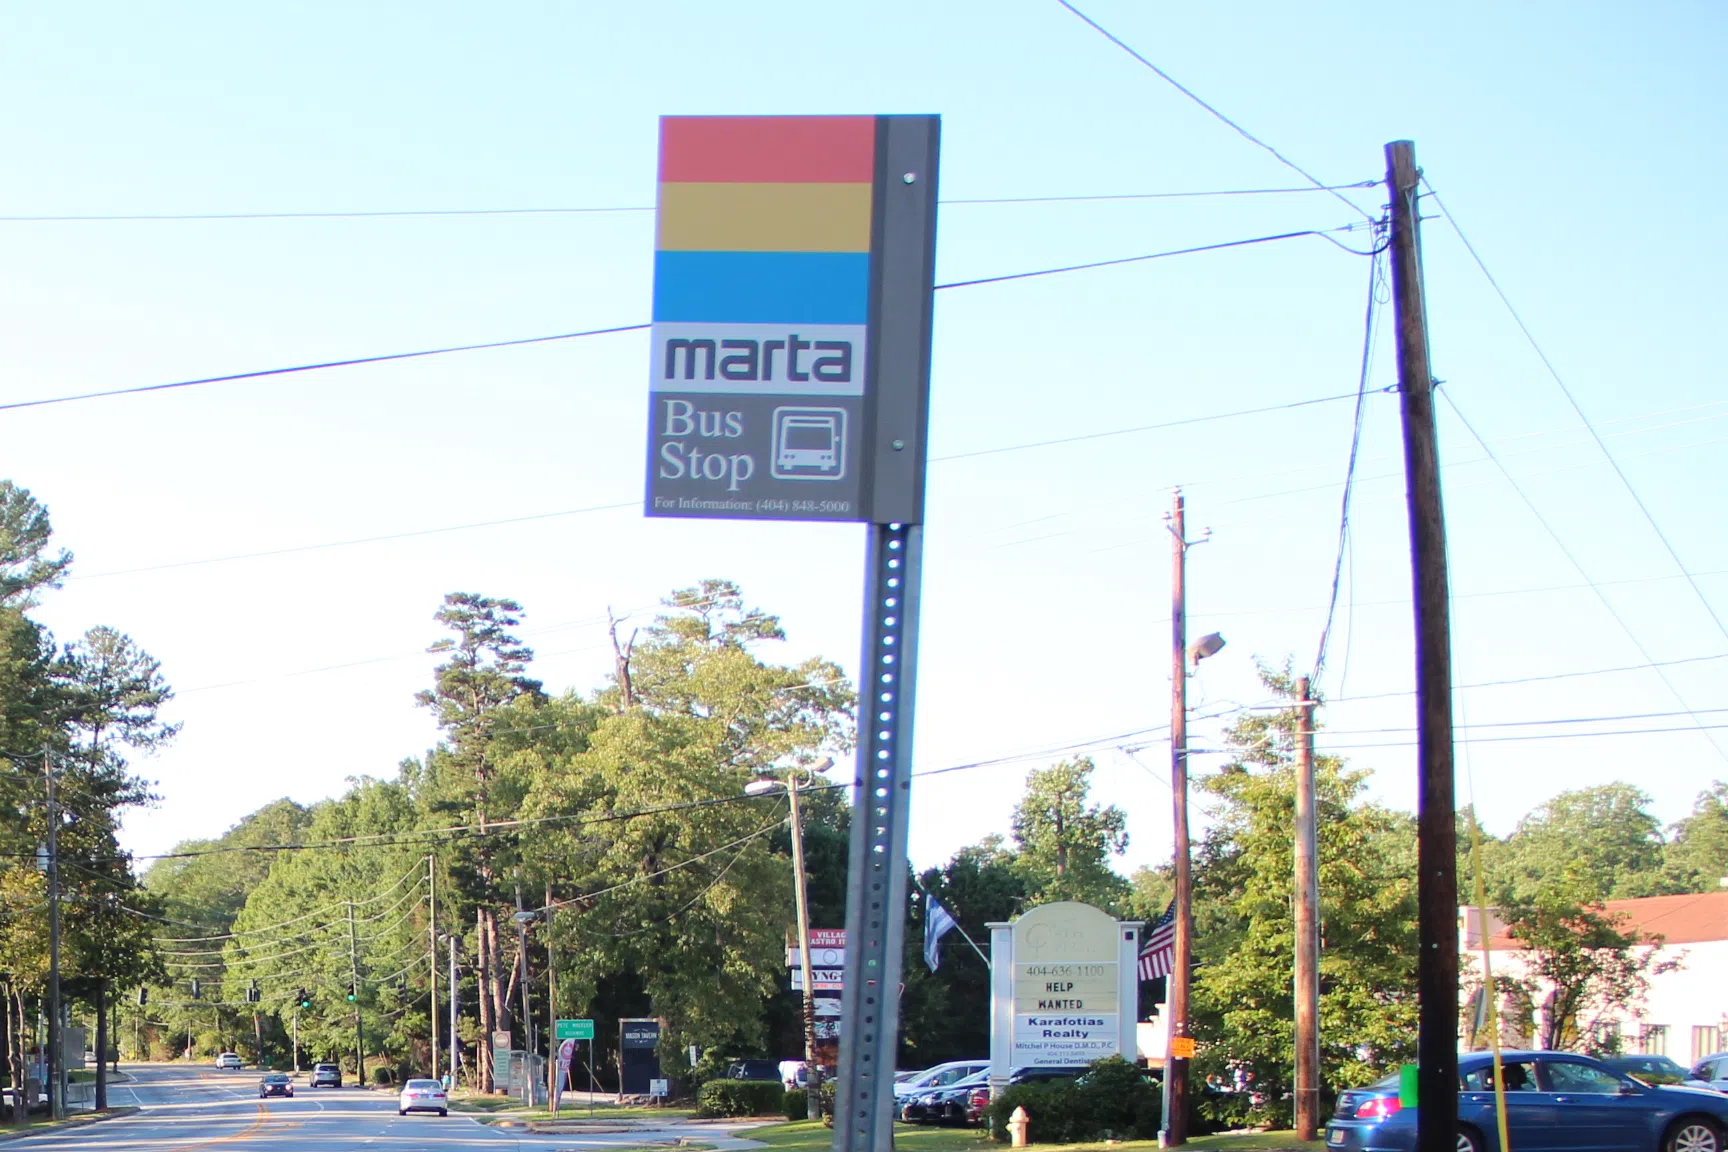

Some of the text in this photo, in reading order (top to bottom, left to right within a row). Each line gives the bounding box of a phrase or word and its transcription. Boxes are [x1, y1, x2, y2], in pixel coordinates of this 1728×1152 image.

[664, 334, 852, 383] marta
[661, 399, 744, 438] Bus
[660, 441, 755, 492] Stop
[654, 496, 850, 513] For Information: (404) 848-5000
[1046, 982, 1074, 992] HELP
[1038, 999, 1083, 1009] WANTED
[1028, 1017, 1104, 1026] Karafotias
[1043, 1029, 1089, 1039] Realty
[1033, 1057, 1063, 1065] General
